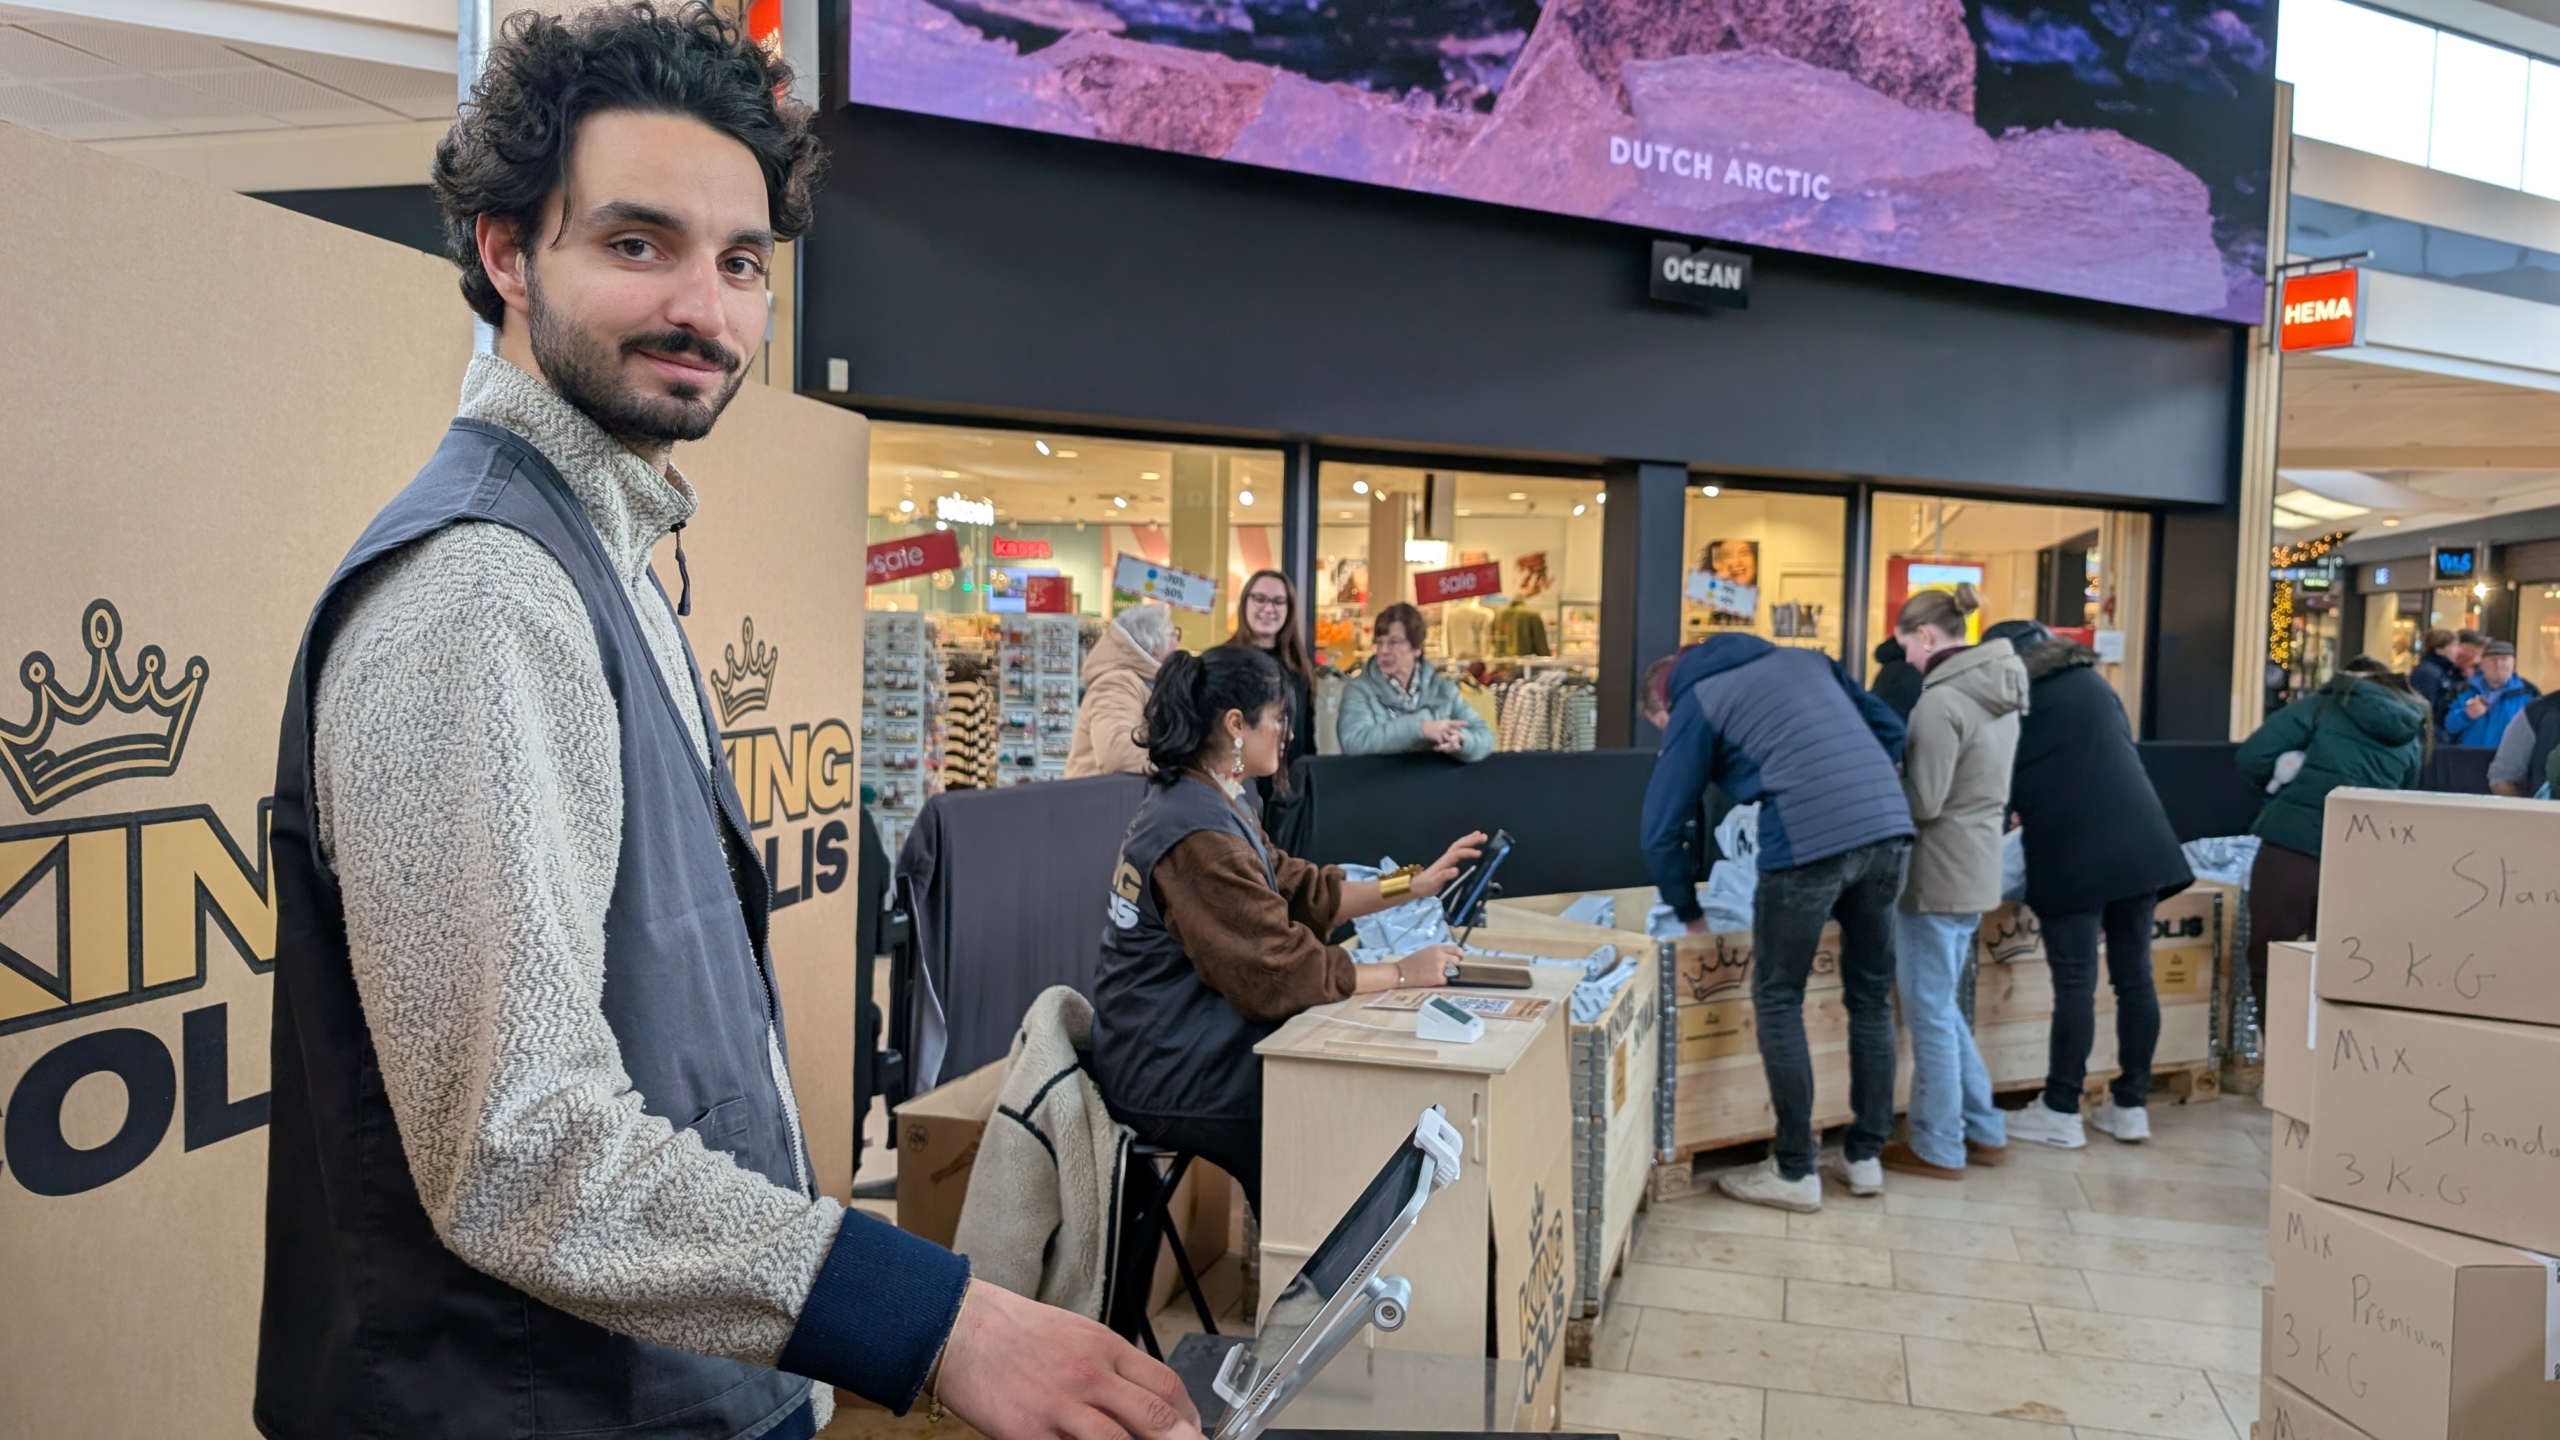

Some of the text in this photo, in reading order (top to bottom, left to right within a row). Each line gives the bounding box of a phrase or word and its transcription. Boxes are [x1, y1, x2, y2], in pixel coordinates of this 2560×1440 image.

[1609, 136, 1831, 201] DUTCH ARCTIC
[1662, 256, 1742, 290] OCEAN
[2284, 296, 2353, 326] HEMA
[993, 536, 1051, 559] kassa
[1438, 572, 1477, 595] sale
[720, 718, 854, 830] ING
[2345, 814, 2416, 844] Mix
[2452, 851, 2560, 919] Stan
[2341, 936, 2374, 983] 3
[2333, 1029, 2413, 1075] Mix
[2336, 1153, 2365, 1186] 3
[2287, 1211, 2332, 1258] Mix
[1518, 1208, 1564, 1358] KING
[2283, 1313, 2301, 1358] 3
[2351, 1273, 2446, 1357] Premium
